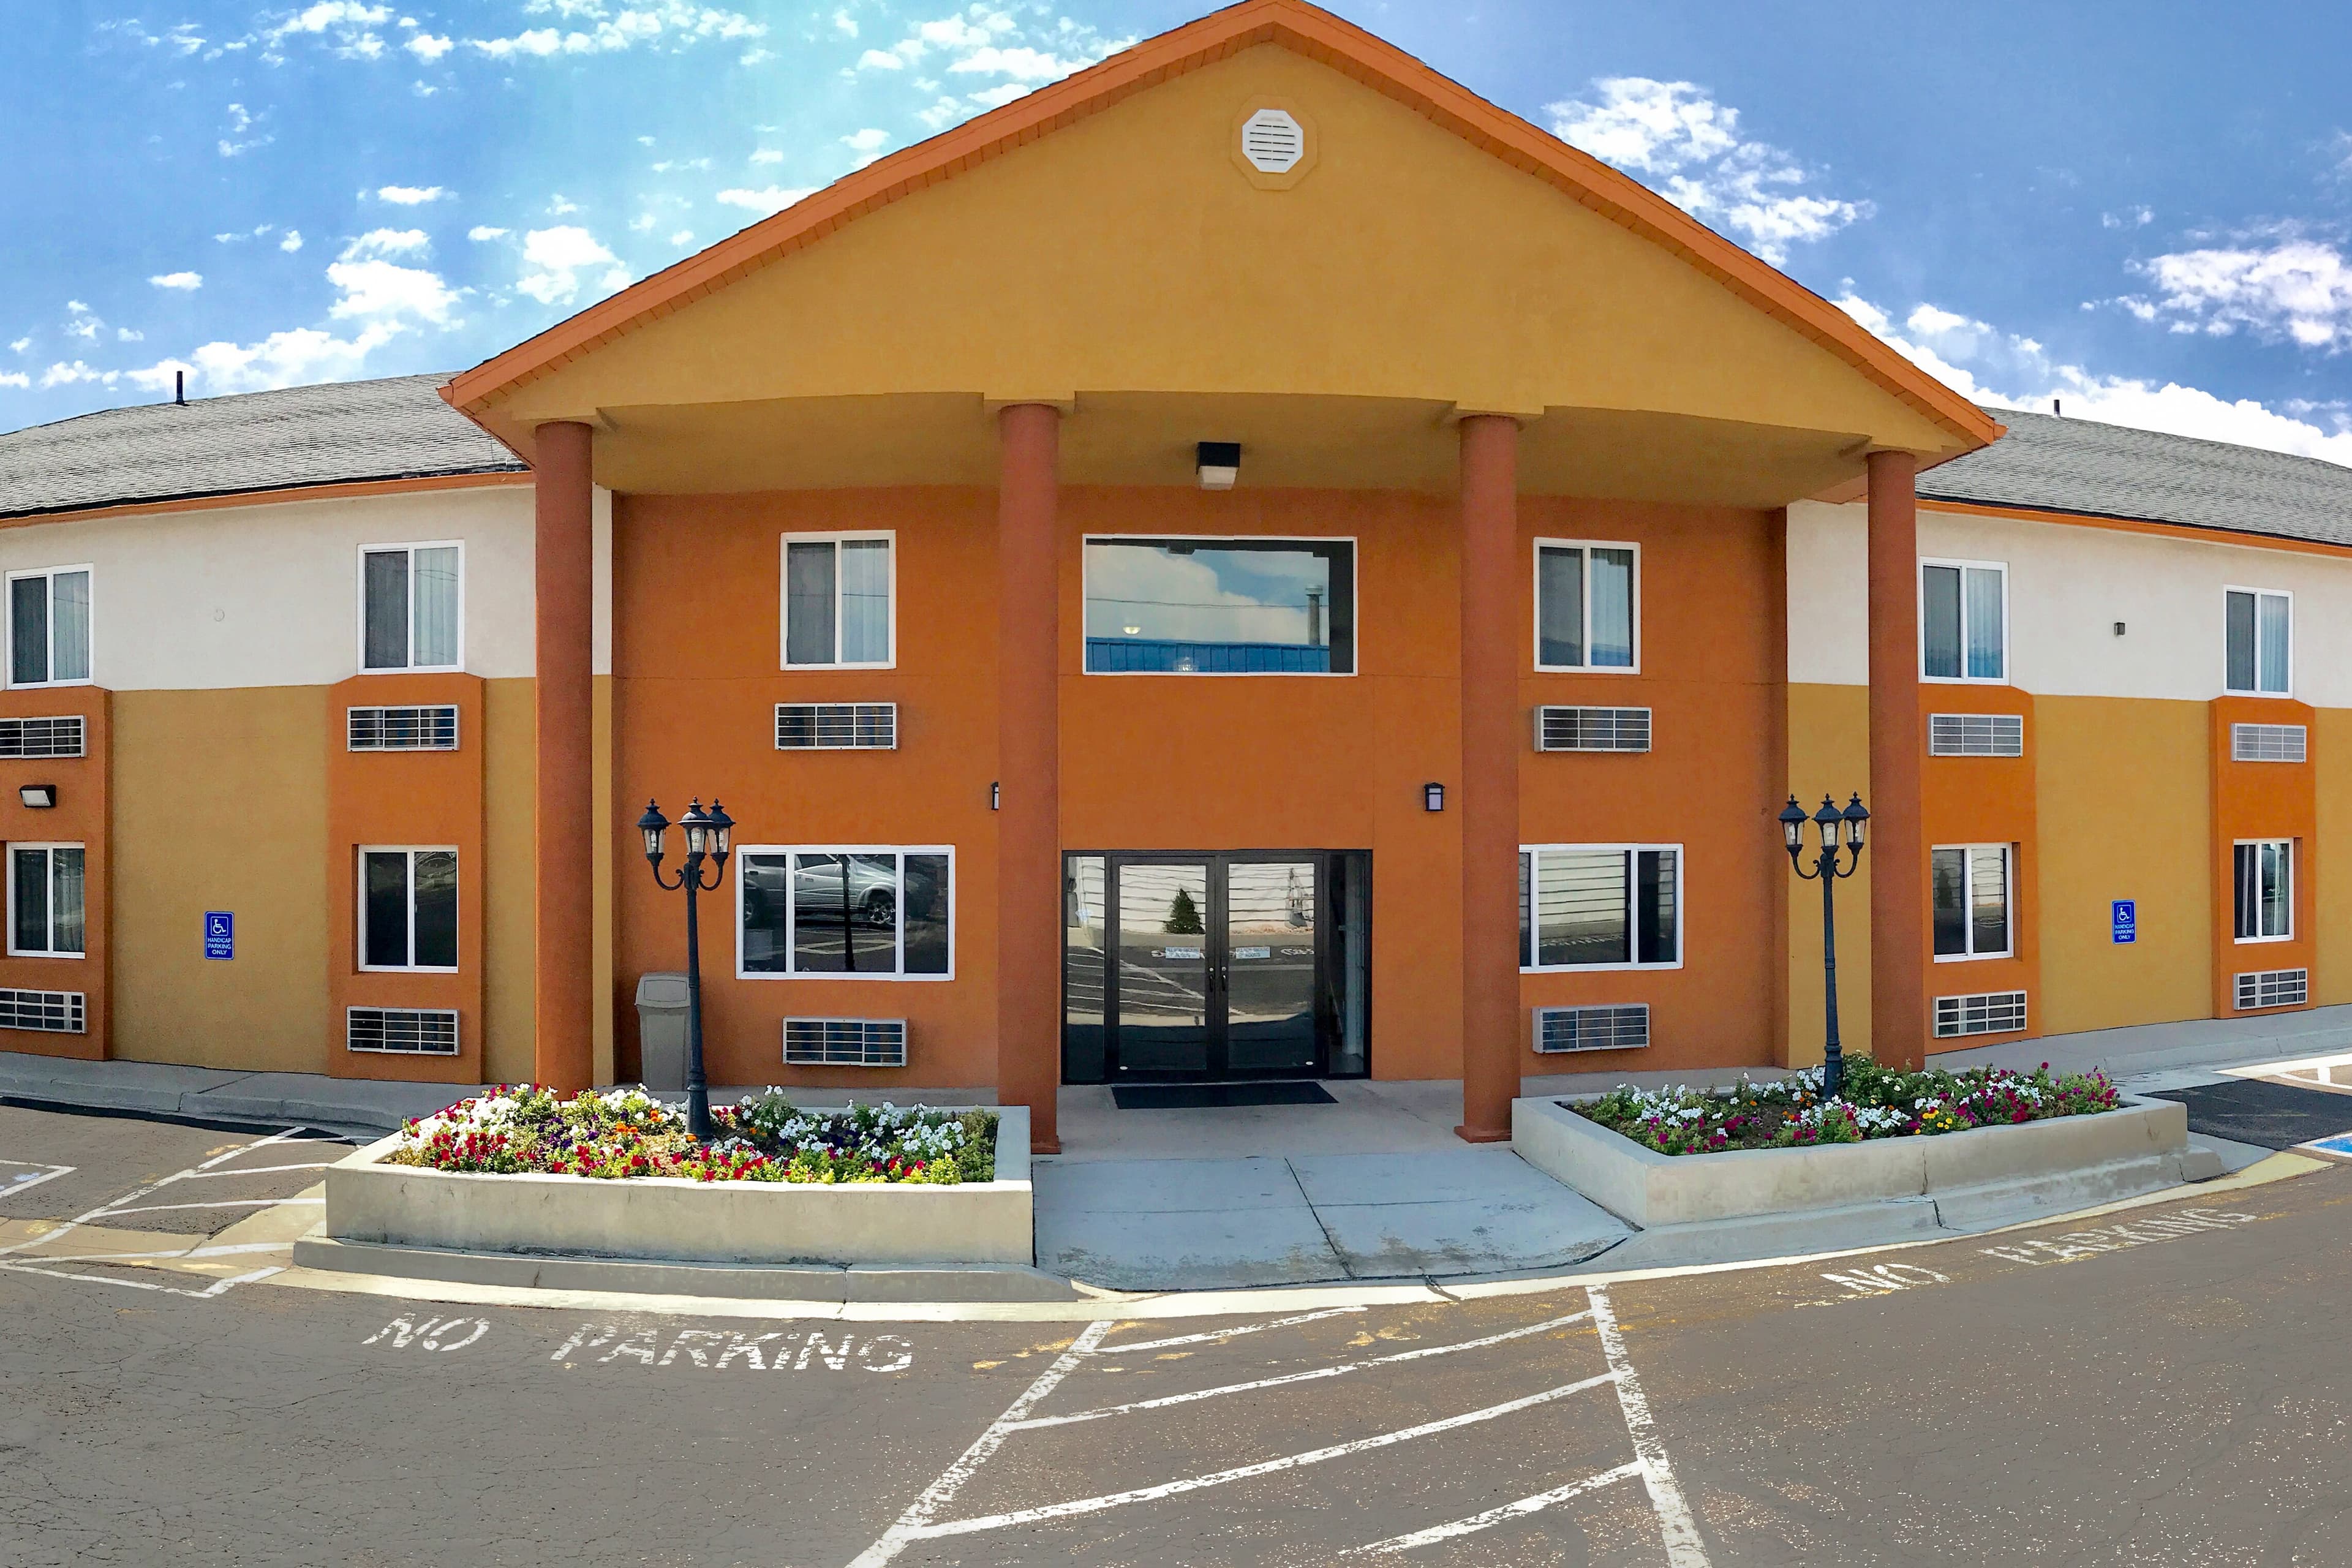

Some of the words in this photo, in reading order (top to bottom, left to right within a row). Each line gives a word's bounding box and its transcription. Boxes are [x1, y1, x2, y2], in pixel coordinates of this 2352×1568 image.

[1819, 1264, 1952, 1291] NO
[1977, 1208, 2258, 1265] PARKING
[361, 1313, 491, 1352] NO
[550, 1323, 912, 1372] PARKING
